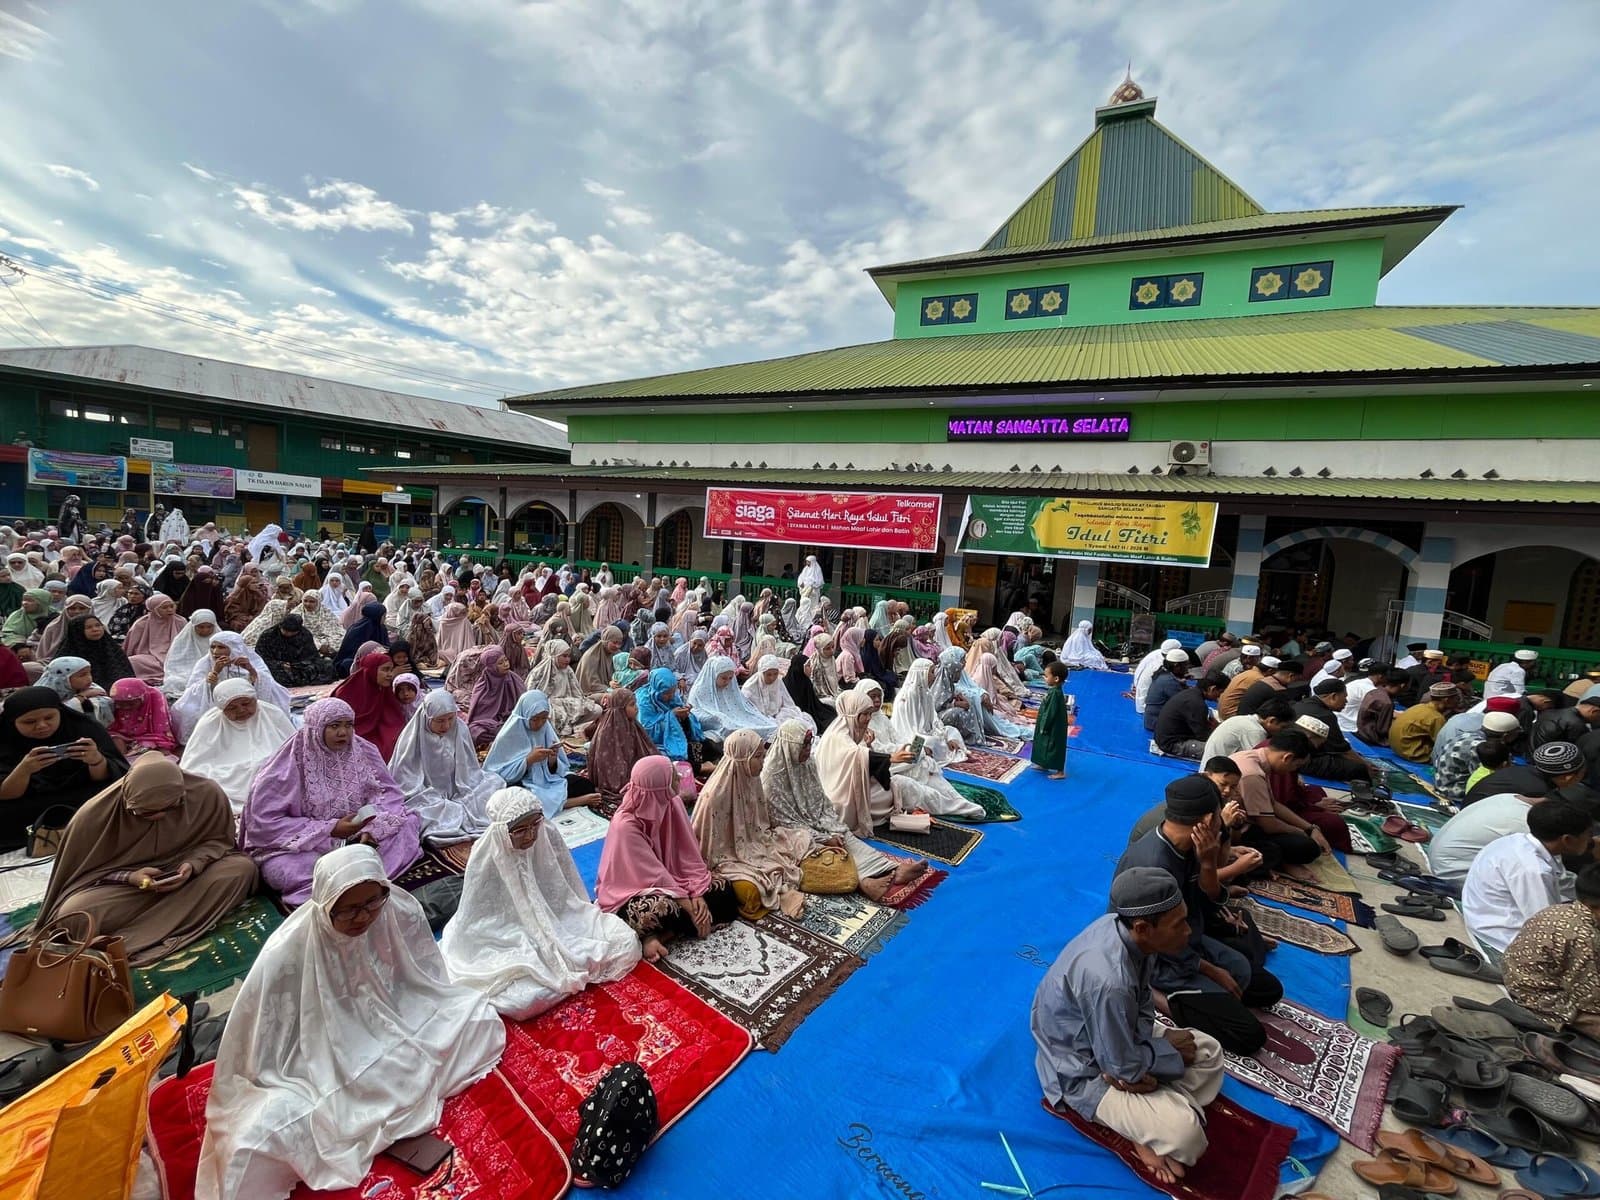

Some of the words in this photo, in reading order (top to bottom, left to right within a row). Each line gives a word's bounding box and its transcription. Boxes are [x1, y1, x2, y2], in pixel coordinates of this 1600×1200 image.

[995, 419, 1068, 434] SANGATTA
[1072, 418, 1129, 433] SELATA
[896, 499, 935, 509] Telkomsel
[735, 505, 775, 521] siaga
[786, 507, 820, 519] Selamat
[821, 508, 842, 520] Hari
[842, 509, 865, 525] Raya
[866, 510, 888, 522] Idul
[889, 510, 912, 523] Fitri
[1067, 526, 1111, 541] Idul
[1119, 528, 1168, 544] Fitri
